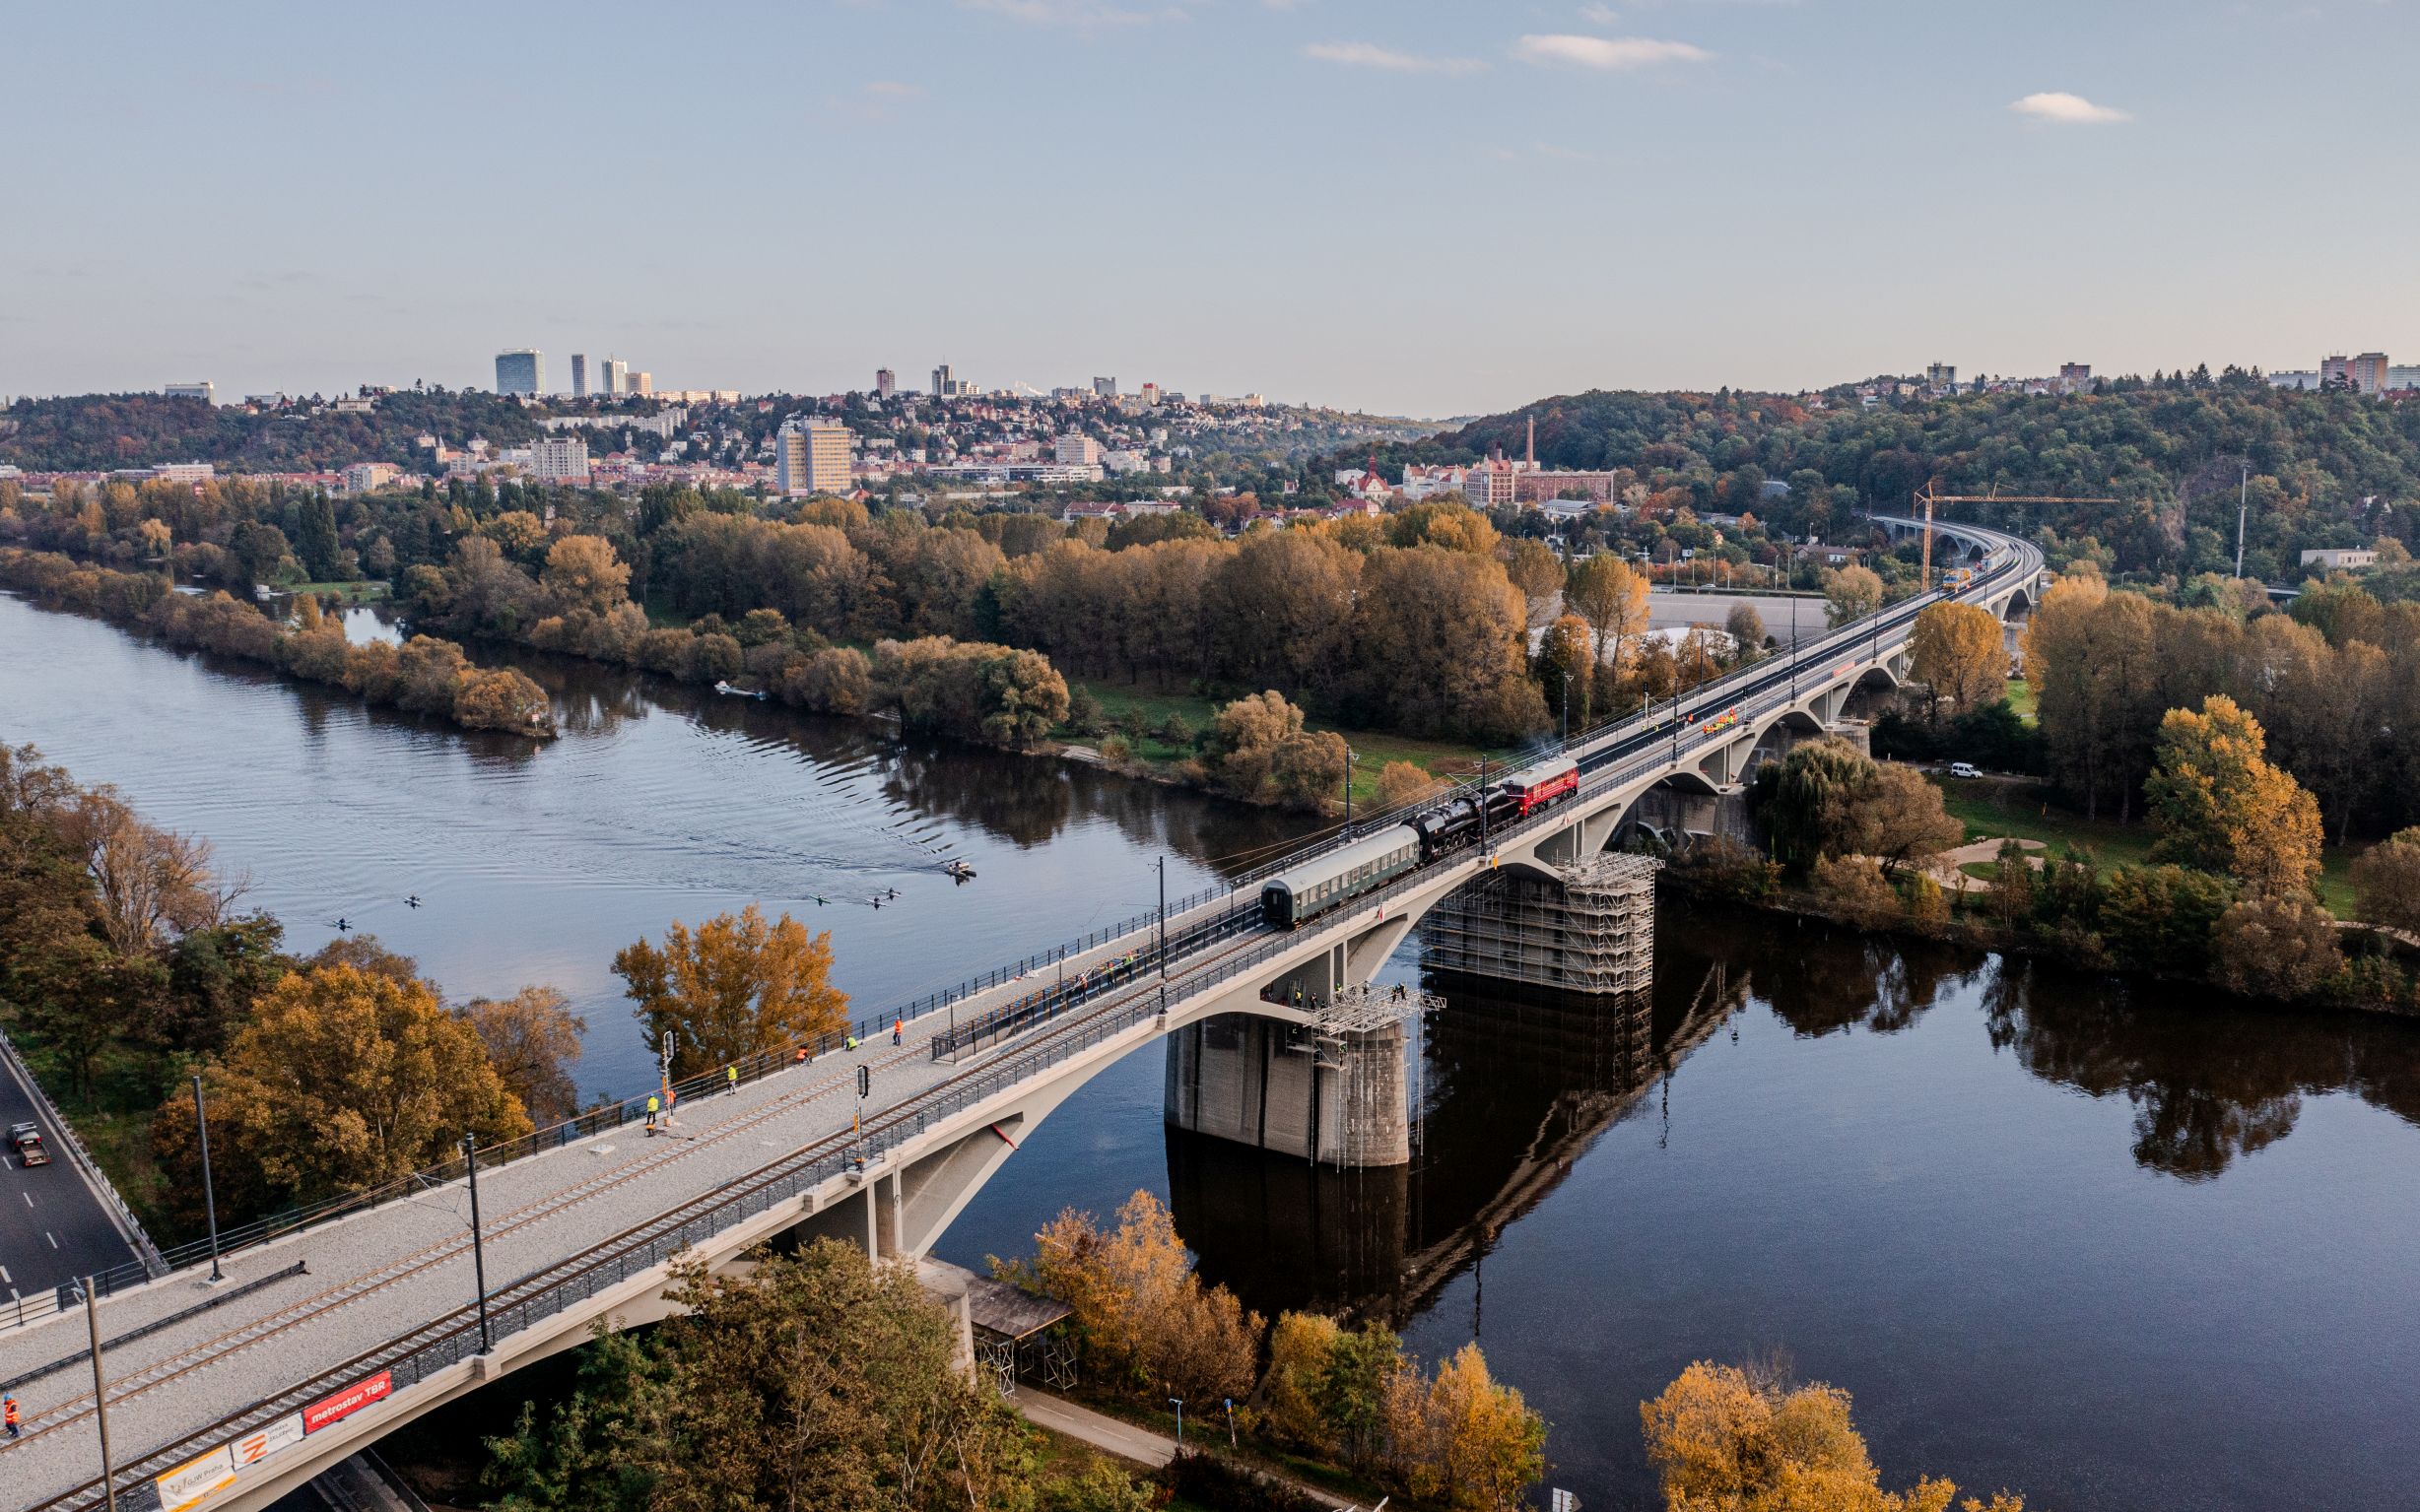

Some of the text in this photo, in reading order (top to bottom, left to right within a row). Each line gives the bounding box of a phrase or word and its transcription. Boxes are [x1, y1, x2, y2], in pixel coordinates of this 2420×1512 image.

[311, 1380, 386, 1423] metrostav TBR
[187, 1464, 224, 1485] GJW Praha
